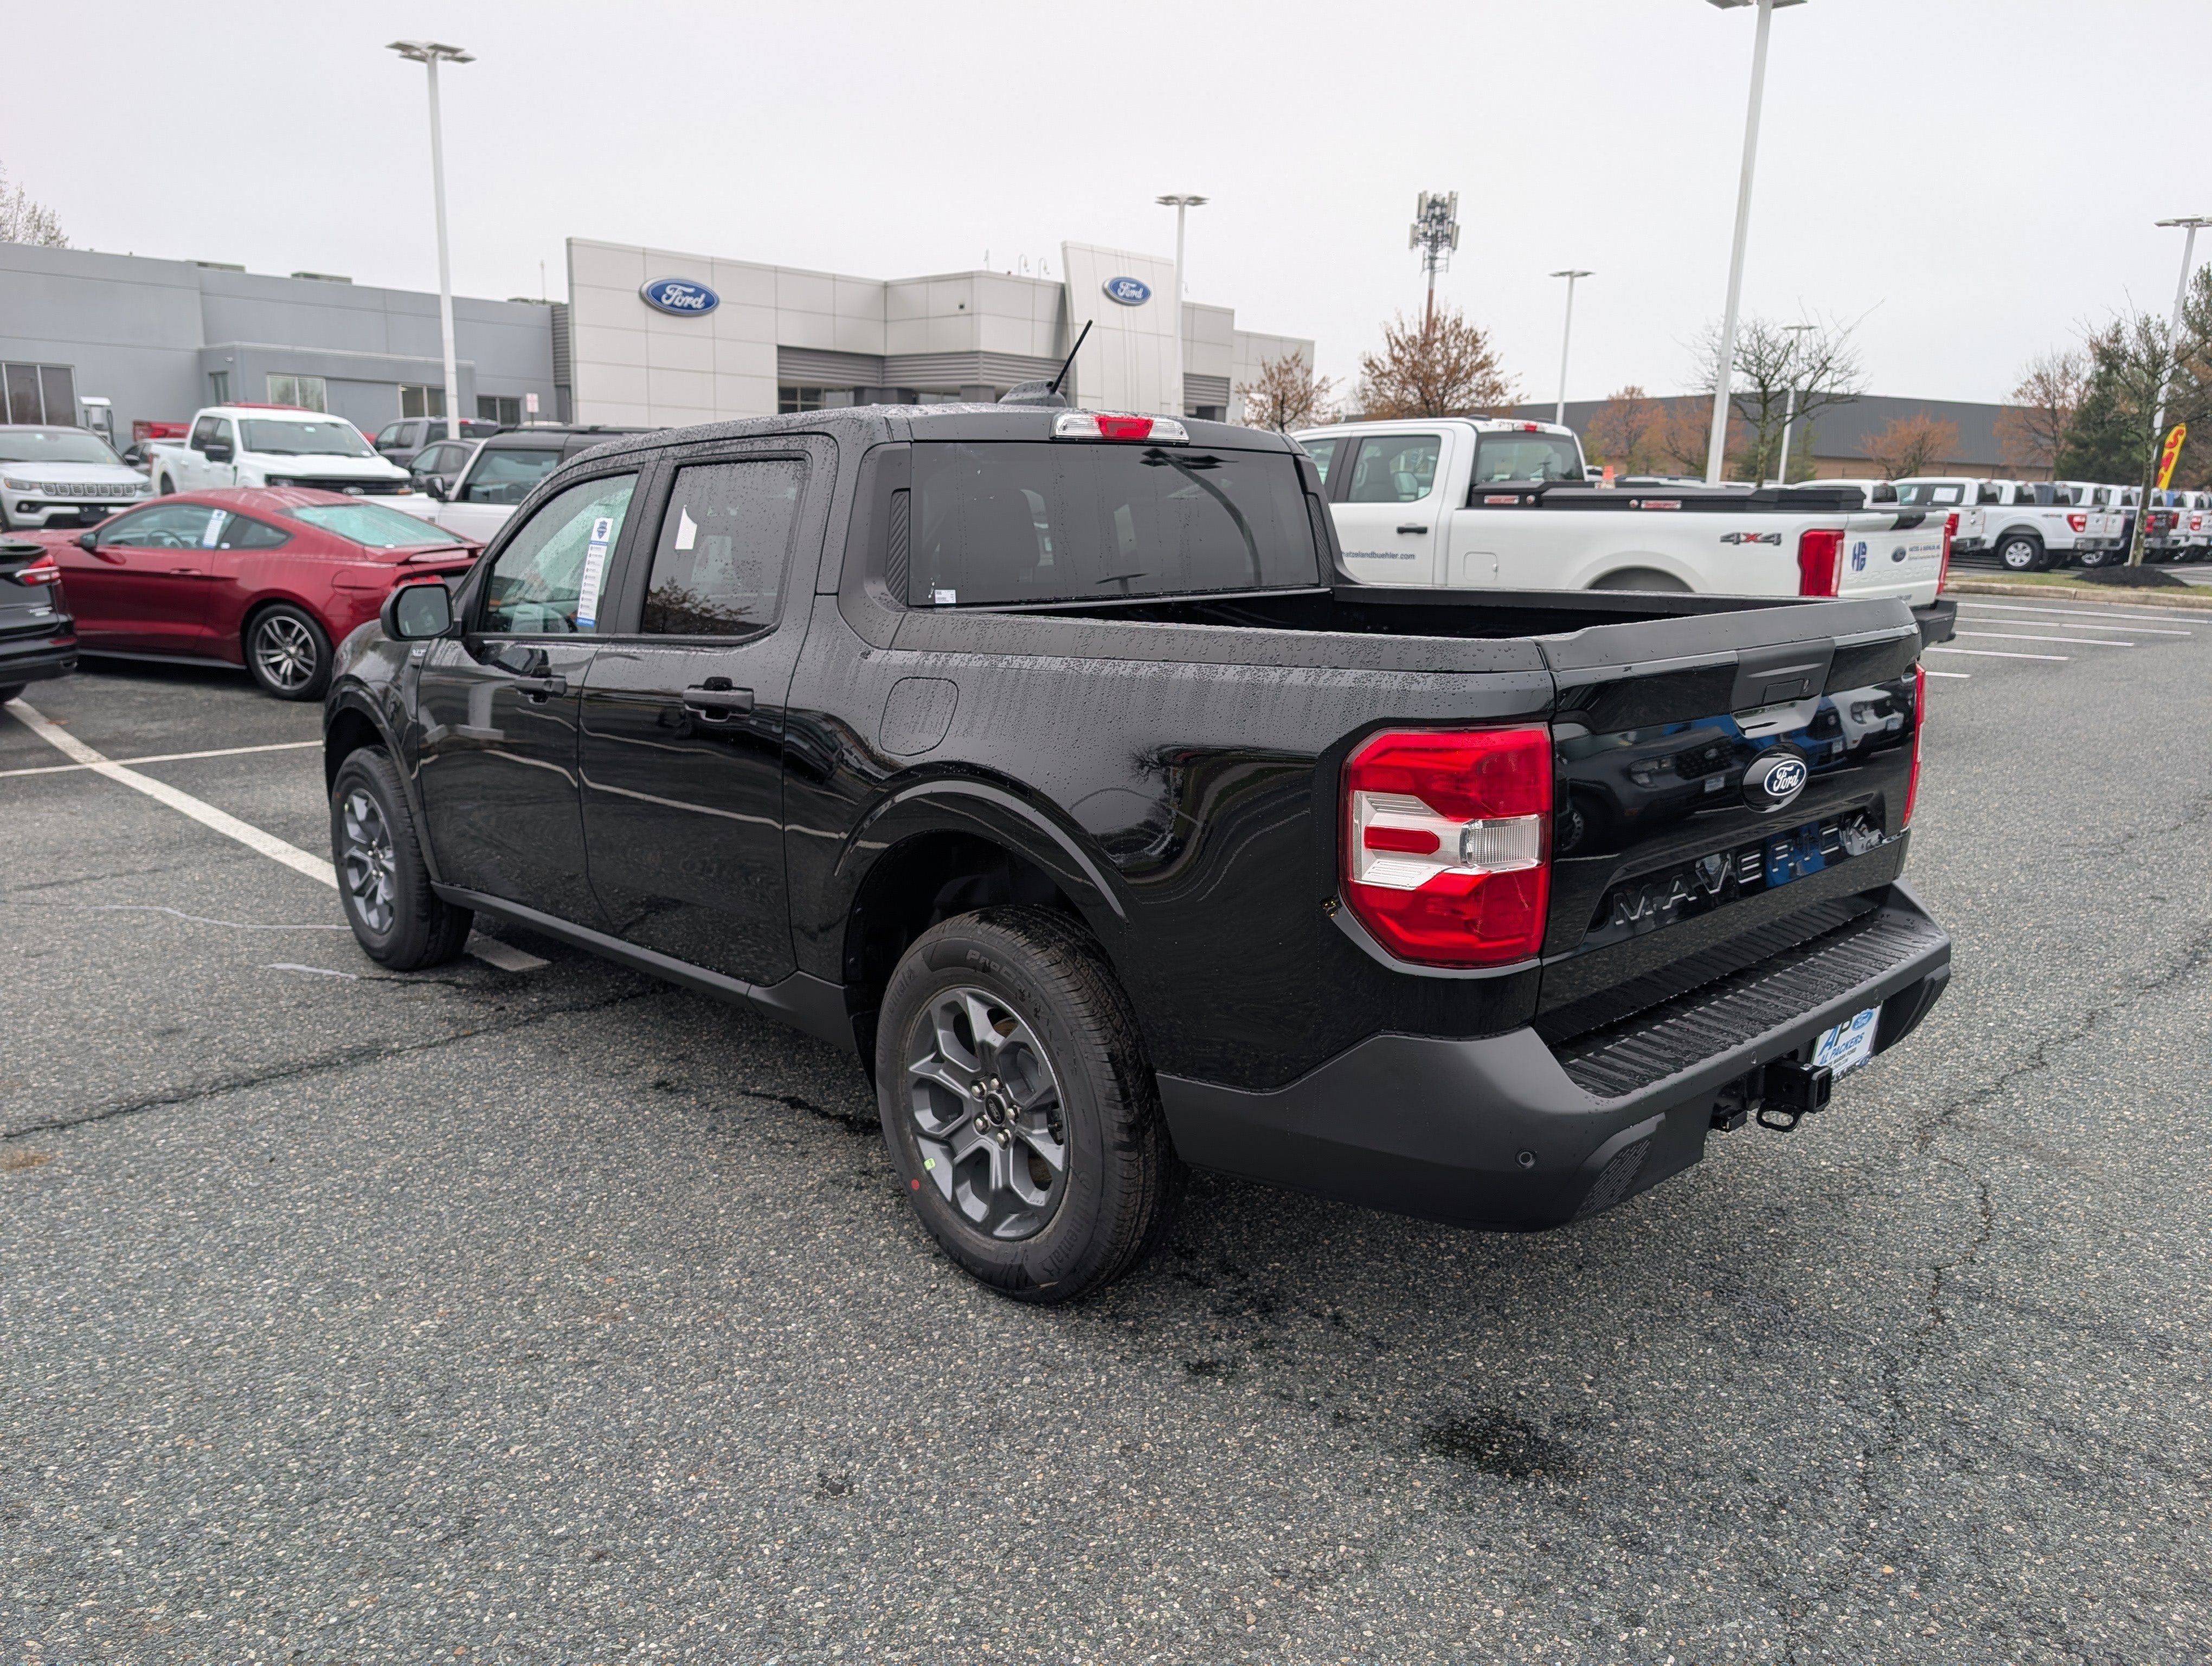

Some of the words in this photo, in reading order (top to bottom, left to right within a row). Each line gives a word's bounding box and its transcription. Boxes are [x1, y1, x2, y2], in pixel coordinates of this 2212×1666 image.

[661, 284, 706, 309] Ford
[1117, 281, 1143, 299] Ford
[1773, 765, 1800, 792] Ford
[1614, 814, 1866, 925] MAVERICK
[1829, 1031, 1865, 1061] PACKERS
